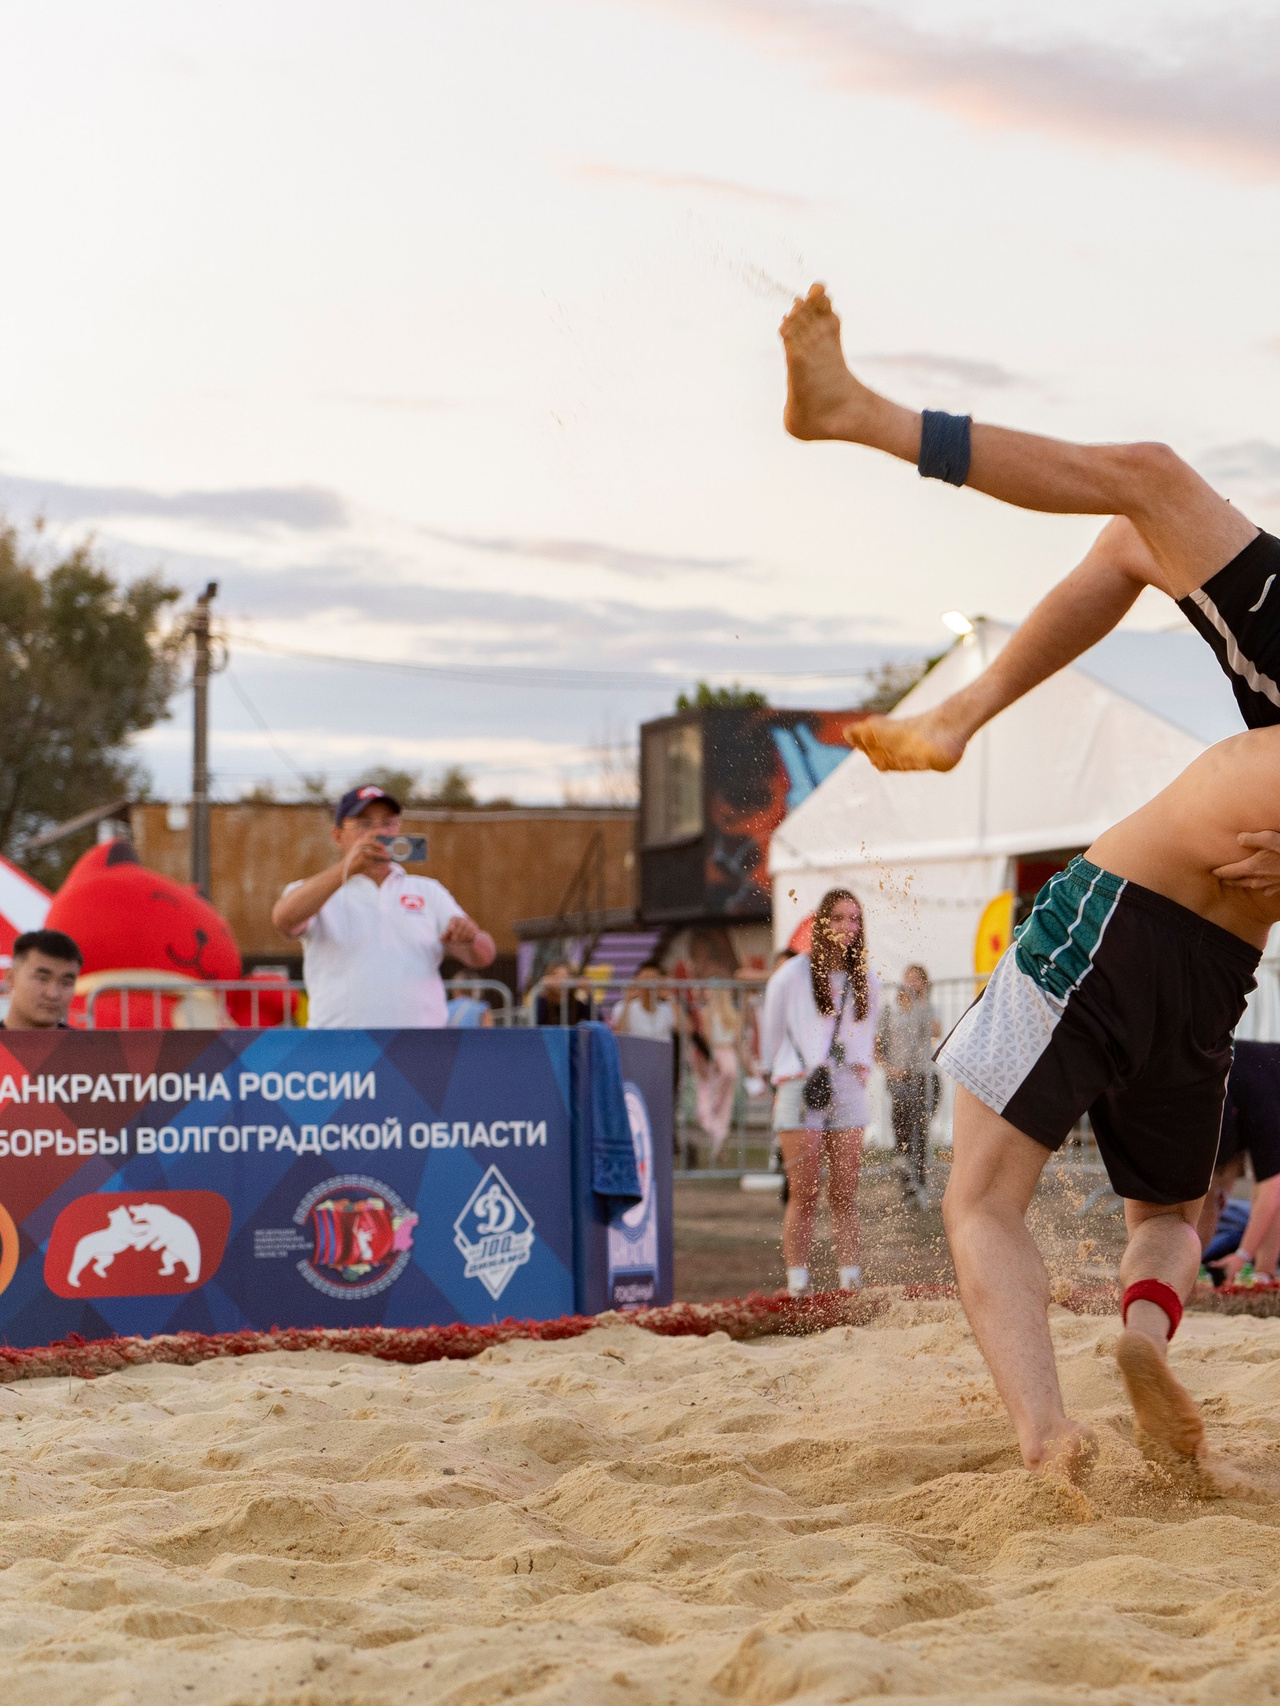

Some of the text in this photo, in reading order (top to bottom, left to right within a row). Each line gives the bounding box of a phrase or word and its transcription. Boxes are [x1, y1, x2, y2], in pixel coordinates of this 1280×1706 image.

[0, 1070, 377, 1104] АНКРАТИОНА РОССИИ
[136, 1117, 403, 1156] ВОЛГОГРАДСКОЙ
[409, 1119, 548, 1150] ОБЛАСТИ
